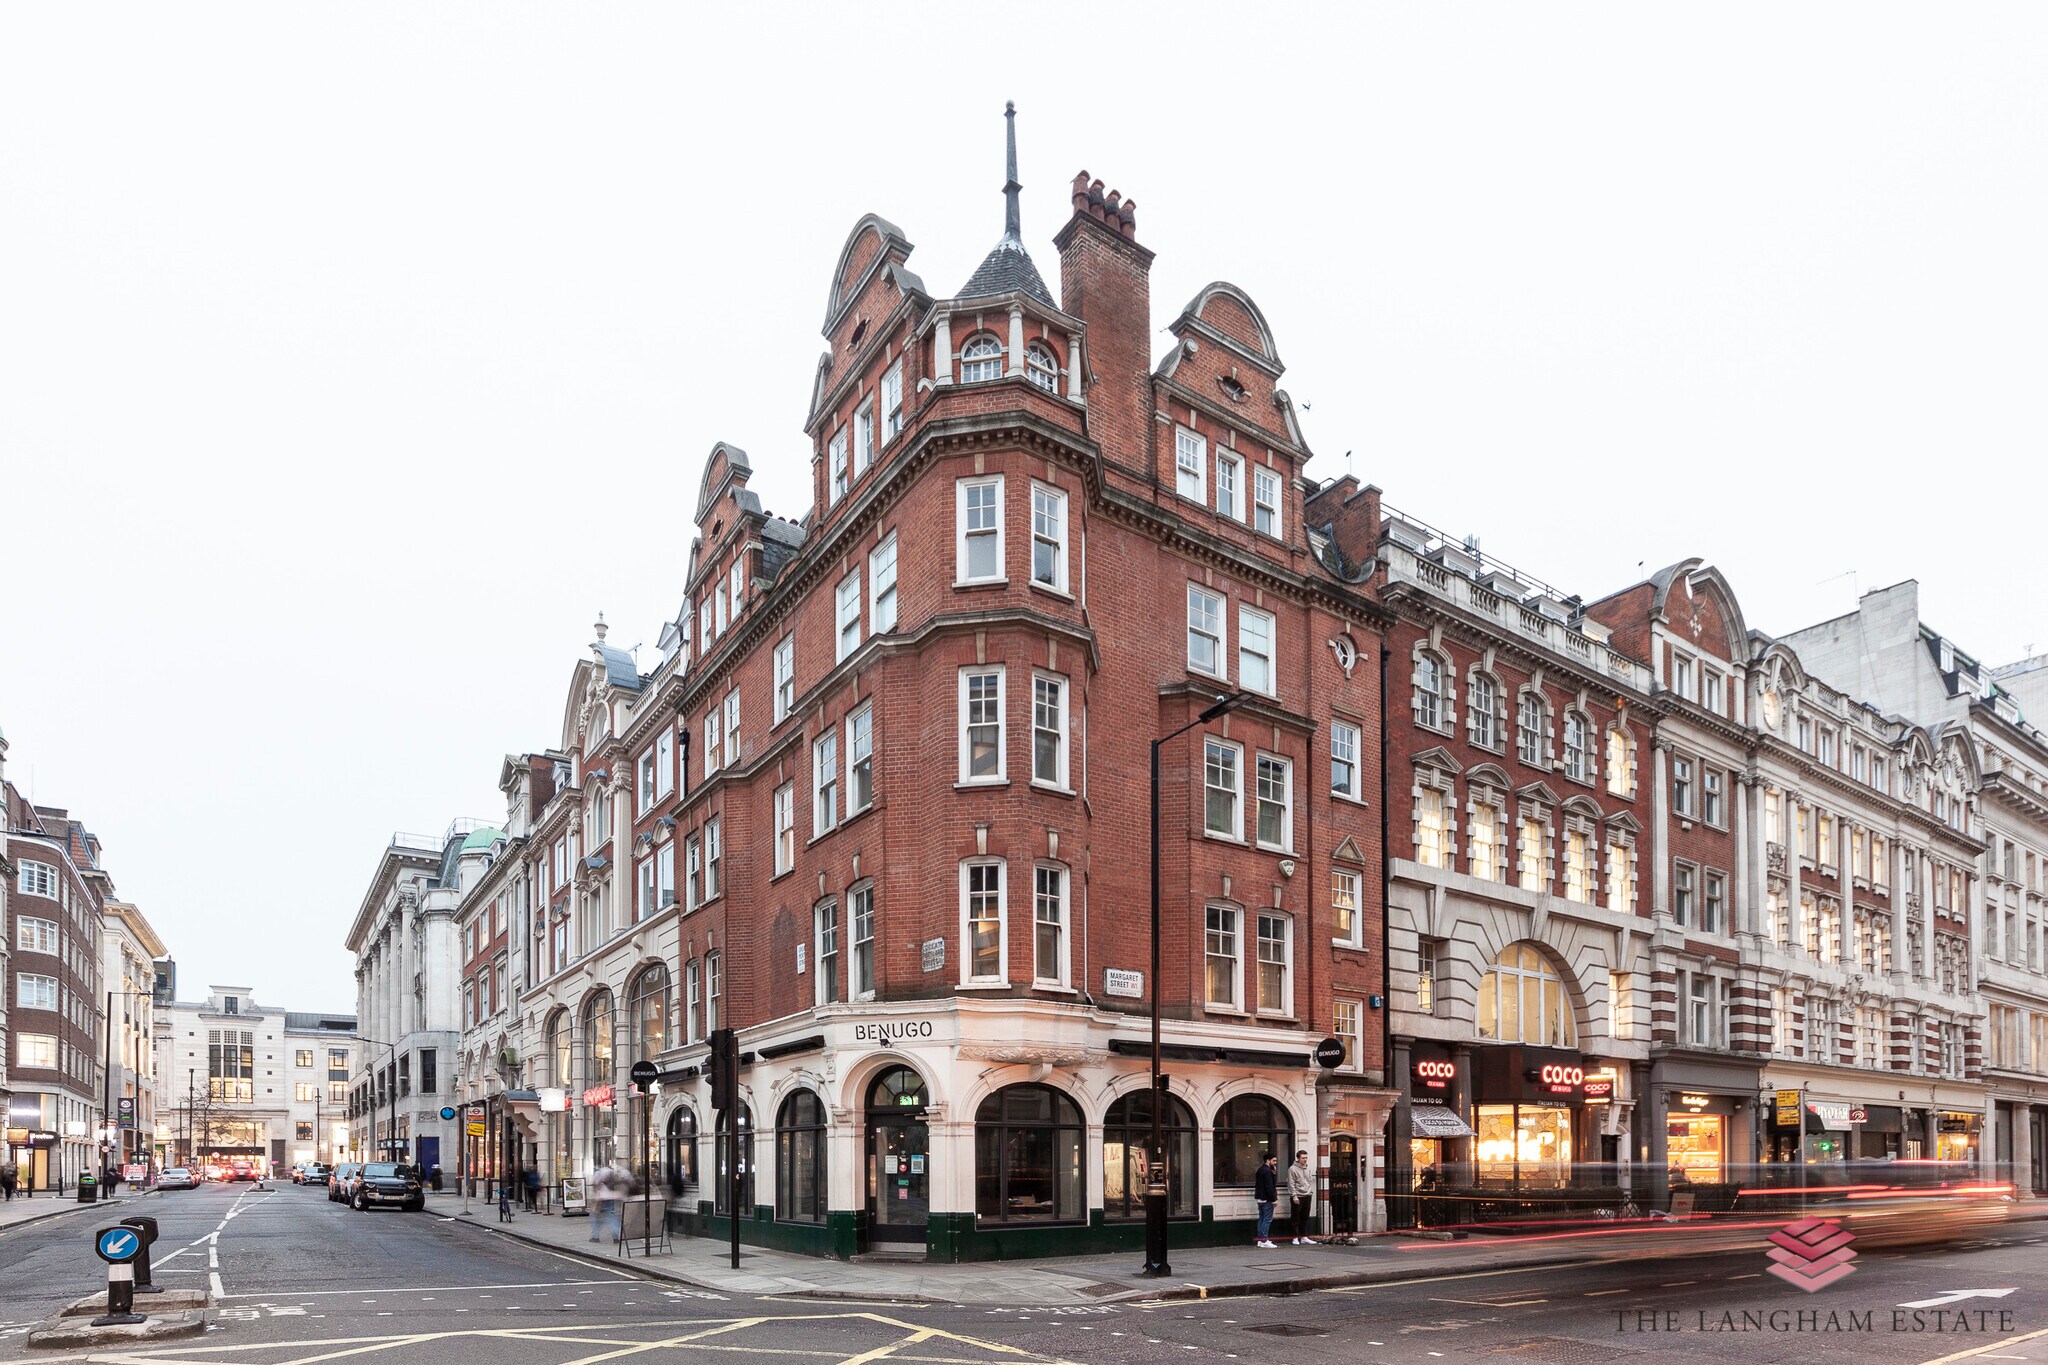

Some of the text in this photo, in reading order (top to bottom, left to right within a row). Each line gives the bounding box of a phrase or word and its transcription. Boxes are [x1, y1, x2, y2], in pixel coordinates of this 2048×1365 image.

[1110, 972, 1138, 982] MARGARET
[1110, 980, 1129, 988] STREET
[855, 1021, 932, 1040] BENUGO
[1418, 1062, 1454, 1078] COCO
[1542, 1065, 1582, 1086] COCO
[1584, 1083, 1610, 1092] COCO
